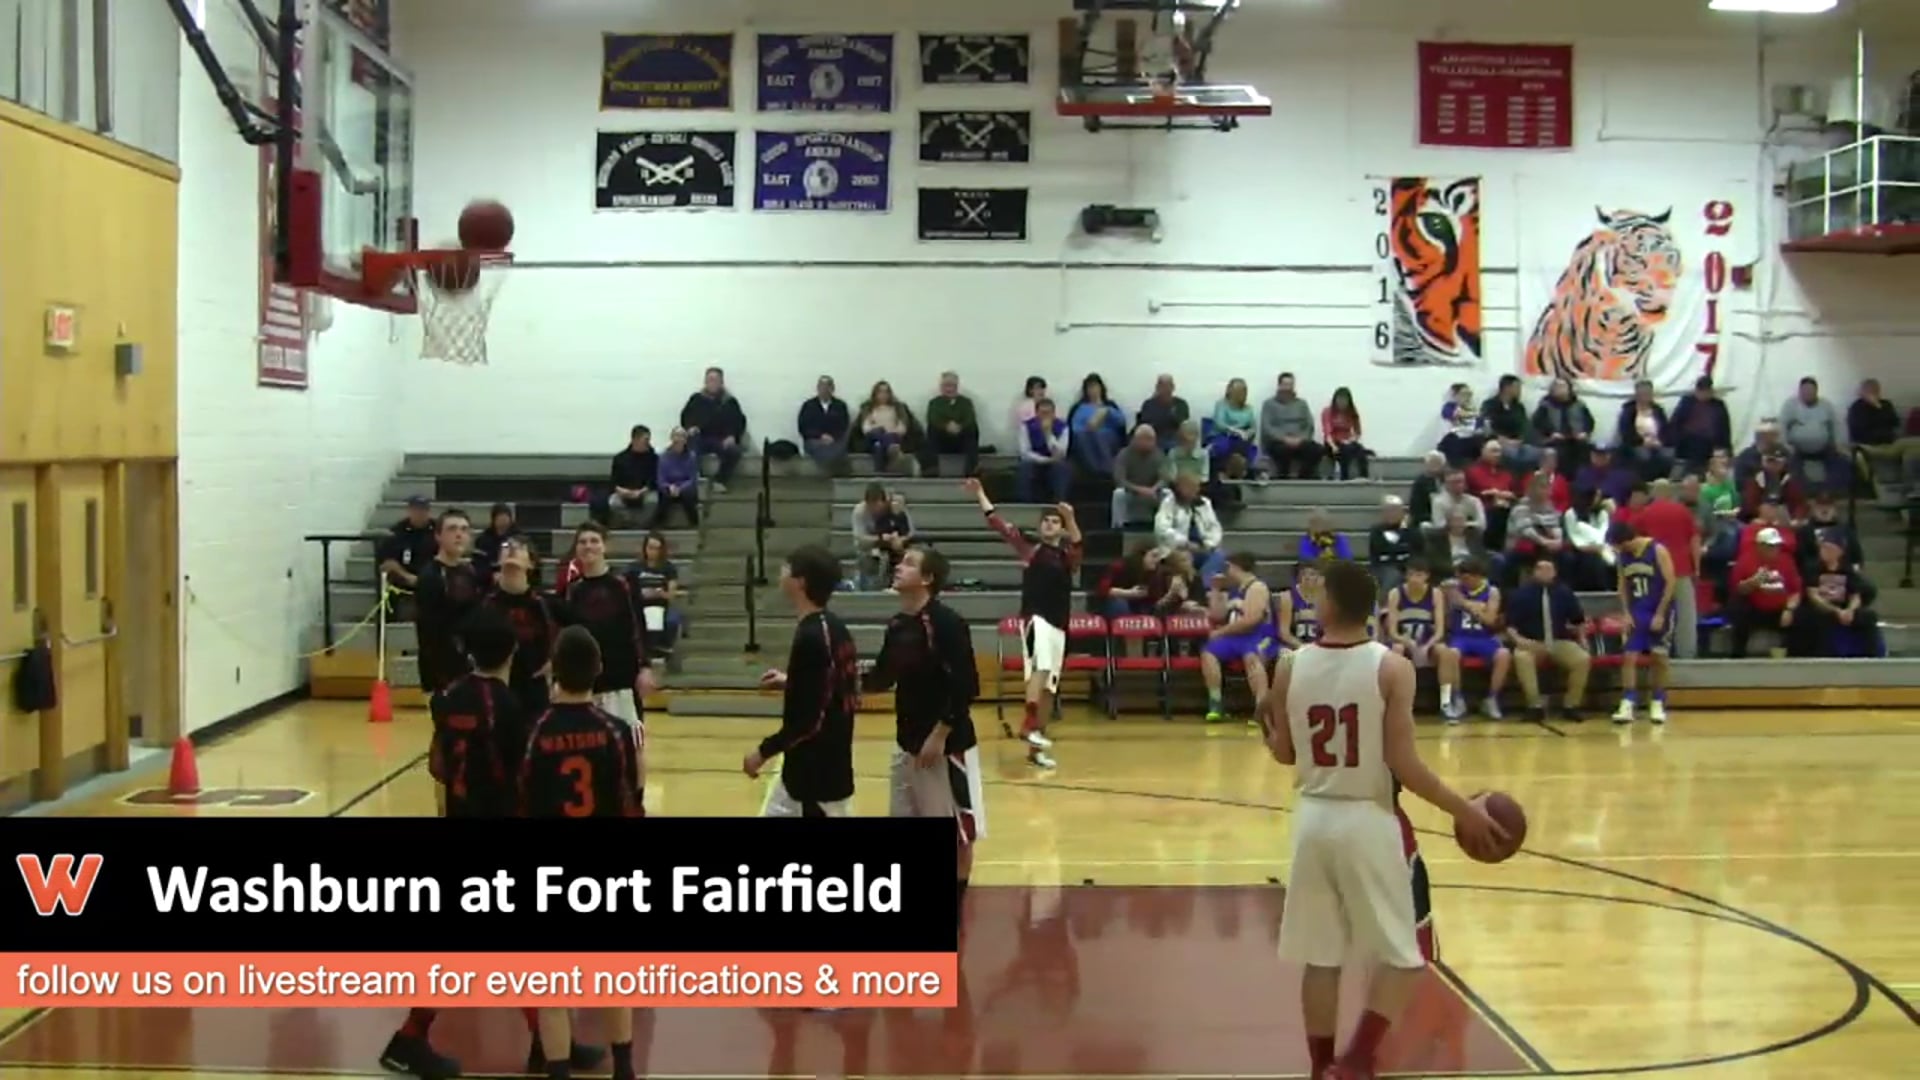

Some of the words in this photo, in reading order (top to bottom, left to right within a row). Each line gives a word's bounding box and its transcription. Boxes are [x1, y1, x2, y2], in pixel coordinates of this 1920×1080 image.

[1373, 188, 1391, 350] 2016
[1695, 200, 1734, 377] 2017
[538, 731, 608, 754] WATSON
[1306, 703, 1359, 768] 21
[559, 755, 597, 817] 3
